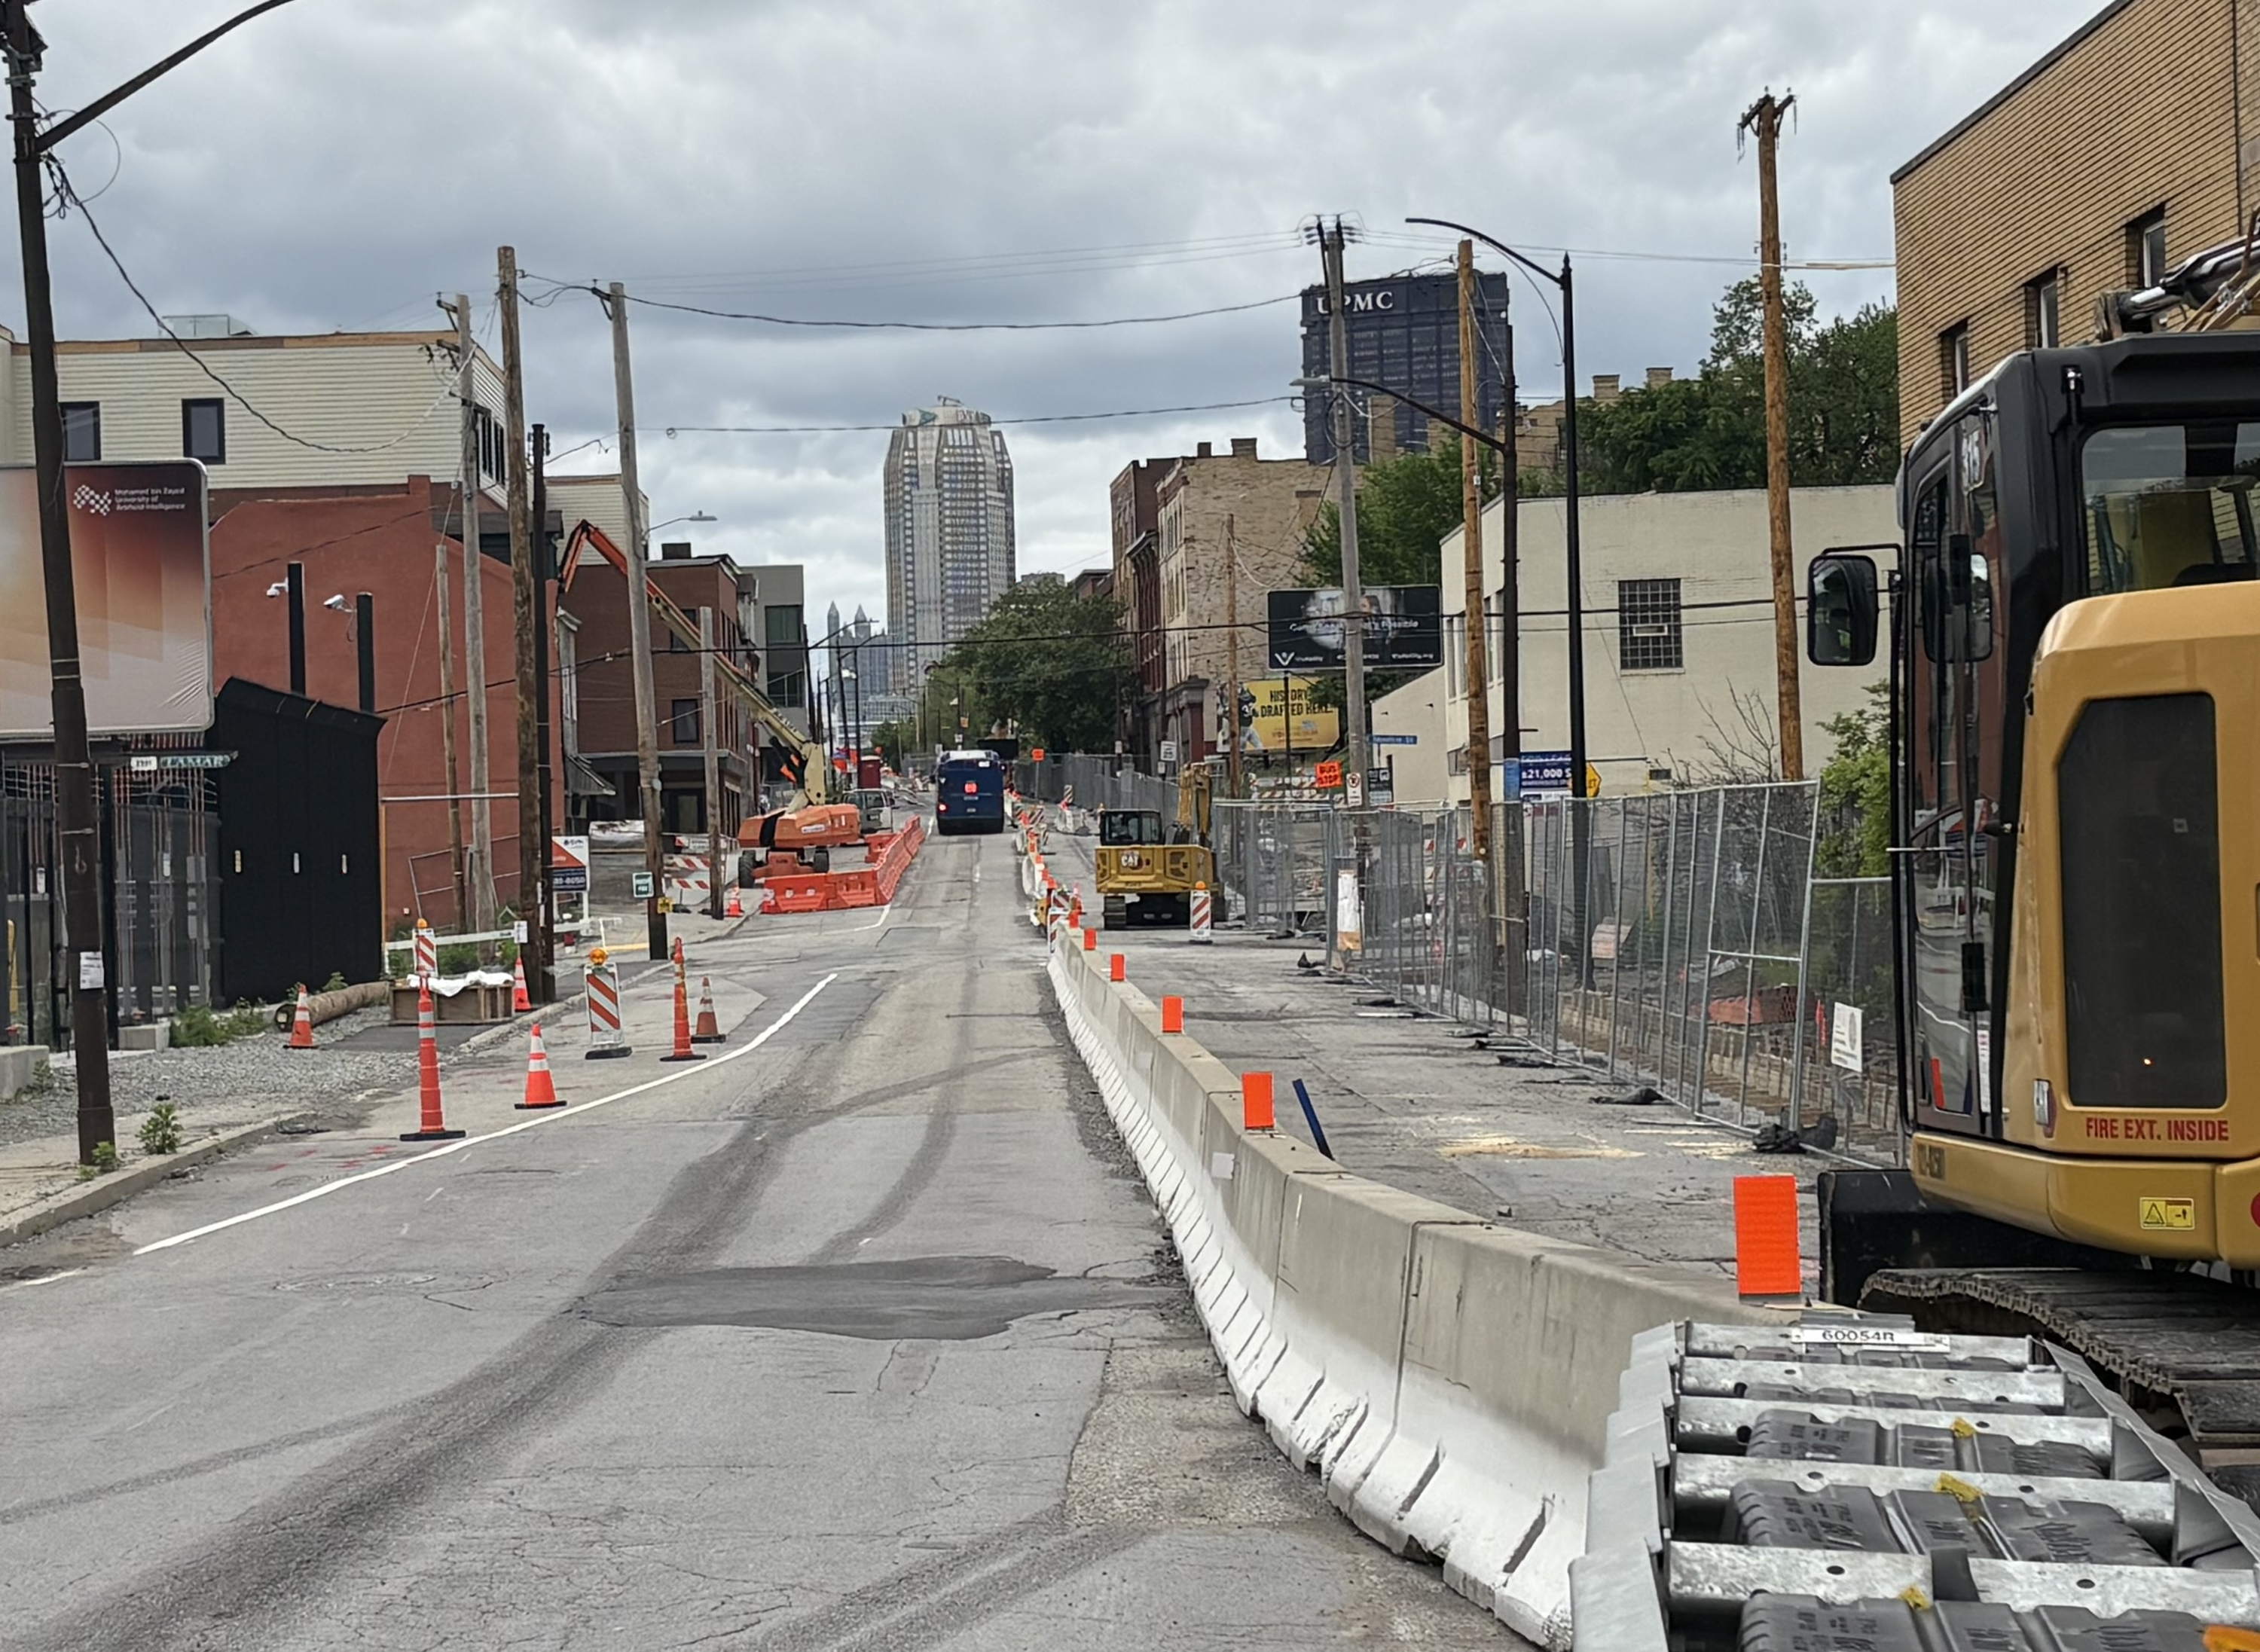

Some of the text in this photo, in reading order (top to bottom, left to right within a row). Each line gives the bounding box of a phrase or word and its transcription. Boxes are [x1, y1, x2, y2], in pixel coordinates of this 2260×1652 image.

[1317, 292, 1393, 313] UPMC
[1270, 689, 1309, 702] HISORY
[1260, 703, 1303, 717] DRAFED
[1121, 856, 1139, 866] CAT
[2086, 1117, 2229, 1141] FIRE EXT. INSIDE
[1822, 1330, 1895, 1342] 60054R
